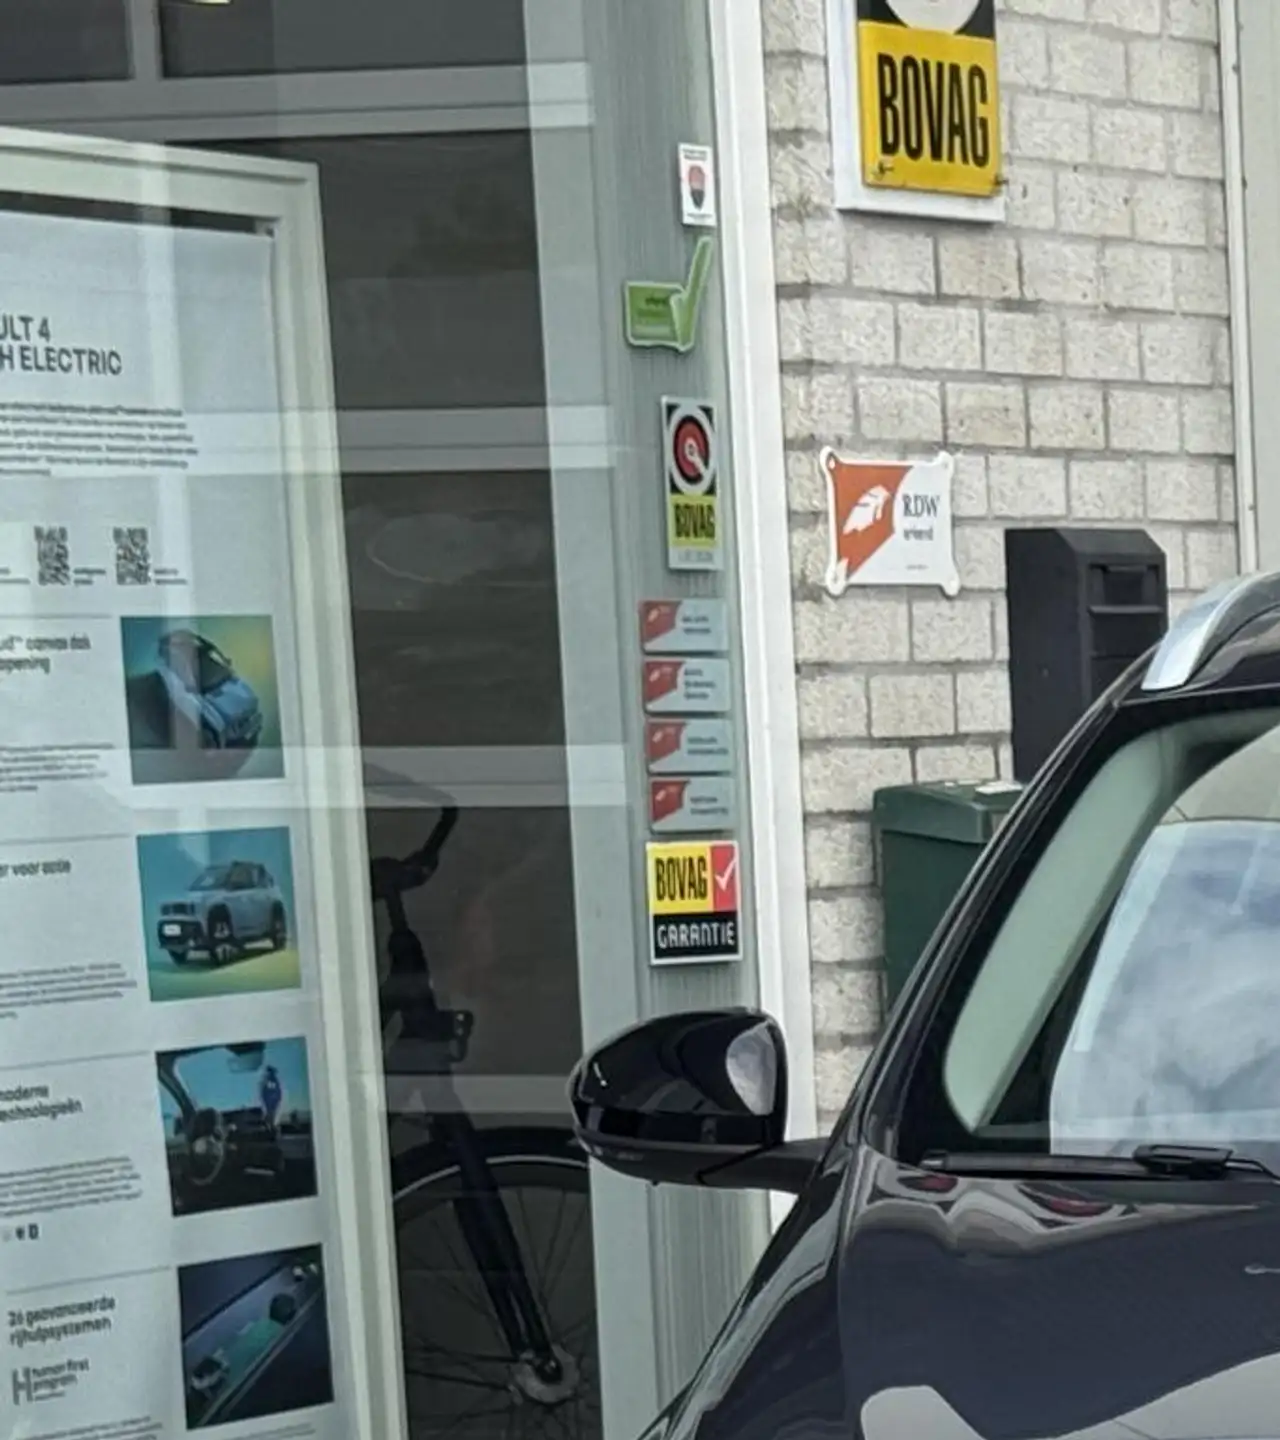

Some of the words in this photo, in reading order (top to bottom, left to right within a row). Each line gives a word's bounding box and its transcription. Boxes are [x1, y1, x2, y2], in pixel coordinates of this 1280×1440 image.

[877, 52, 990, 168] BOVAG
[37, 316, 51, 342] 4
[19, 346, 123, 376] ELECTRIC
[655, 856, 708, 901] BOVAG
[657, 921, 736, 949] GARANTIE
